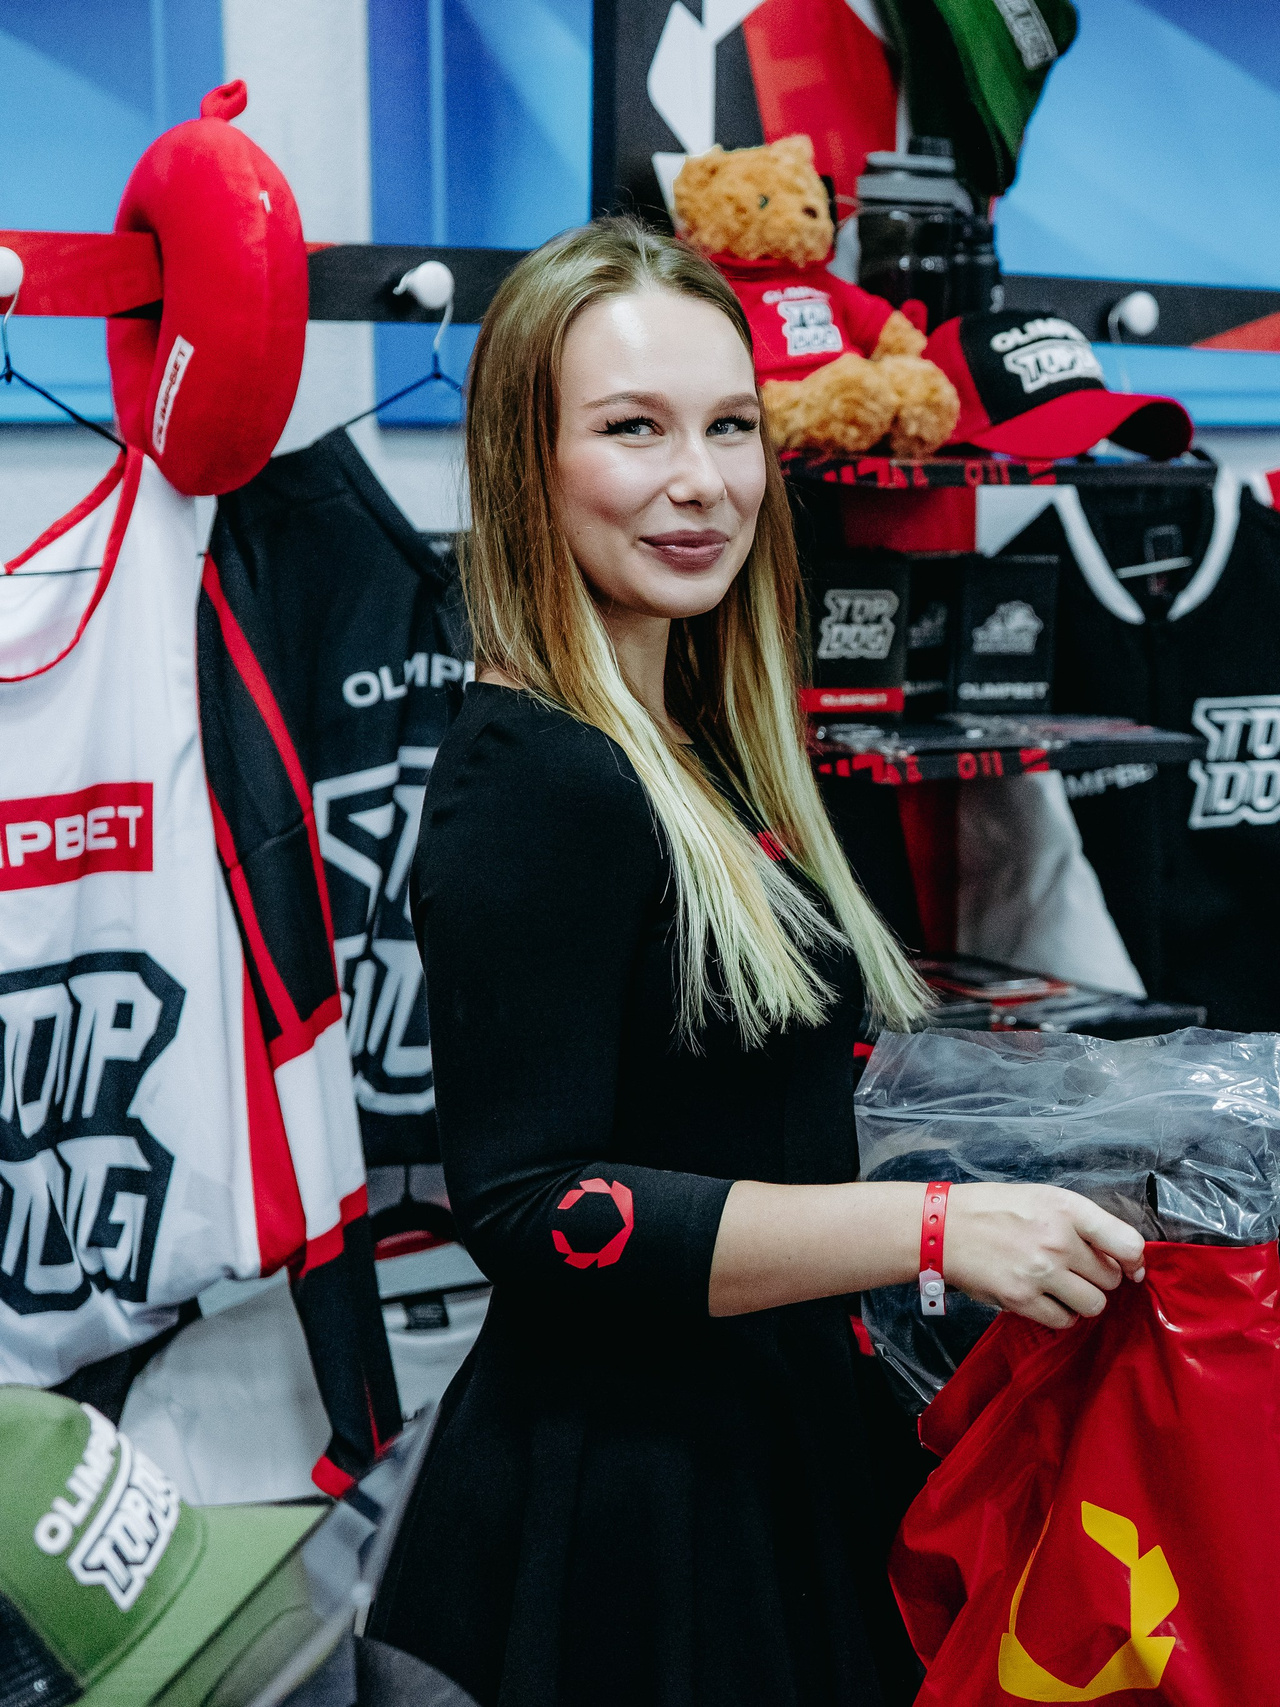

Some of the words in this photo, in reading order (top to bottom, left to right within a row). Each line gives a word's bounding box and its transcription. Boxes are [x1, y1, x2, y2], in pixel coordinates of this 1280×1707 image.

[343, 652, 476, 708] OLMP
[0, 805, 144, 868] PBET
[0, 969, 163, 1140] OP
[0, 1134, 153, 1296] OG
